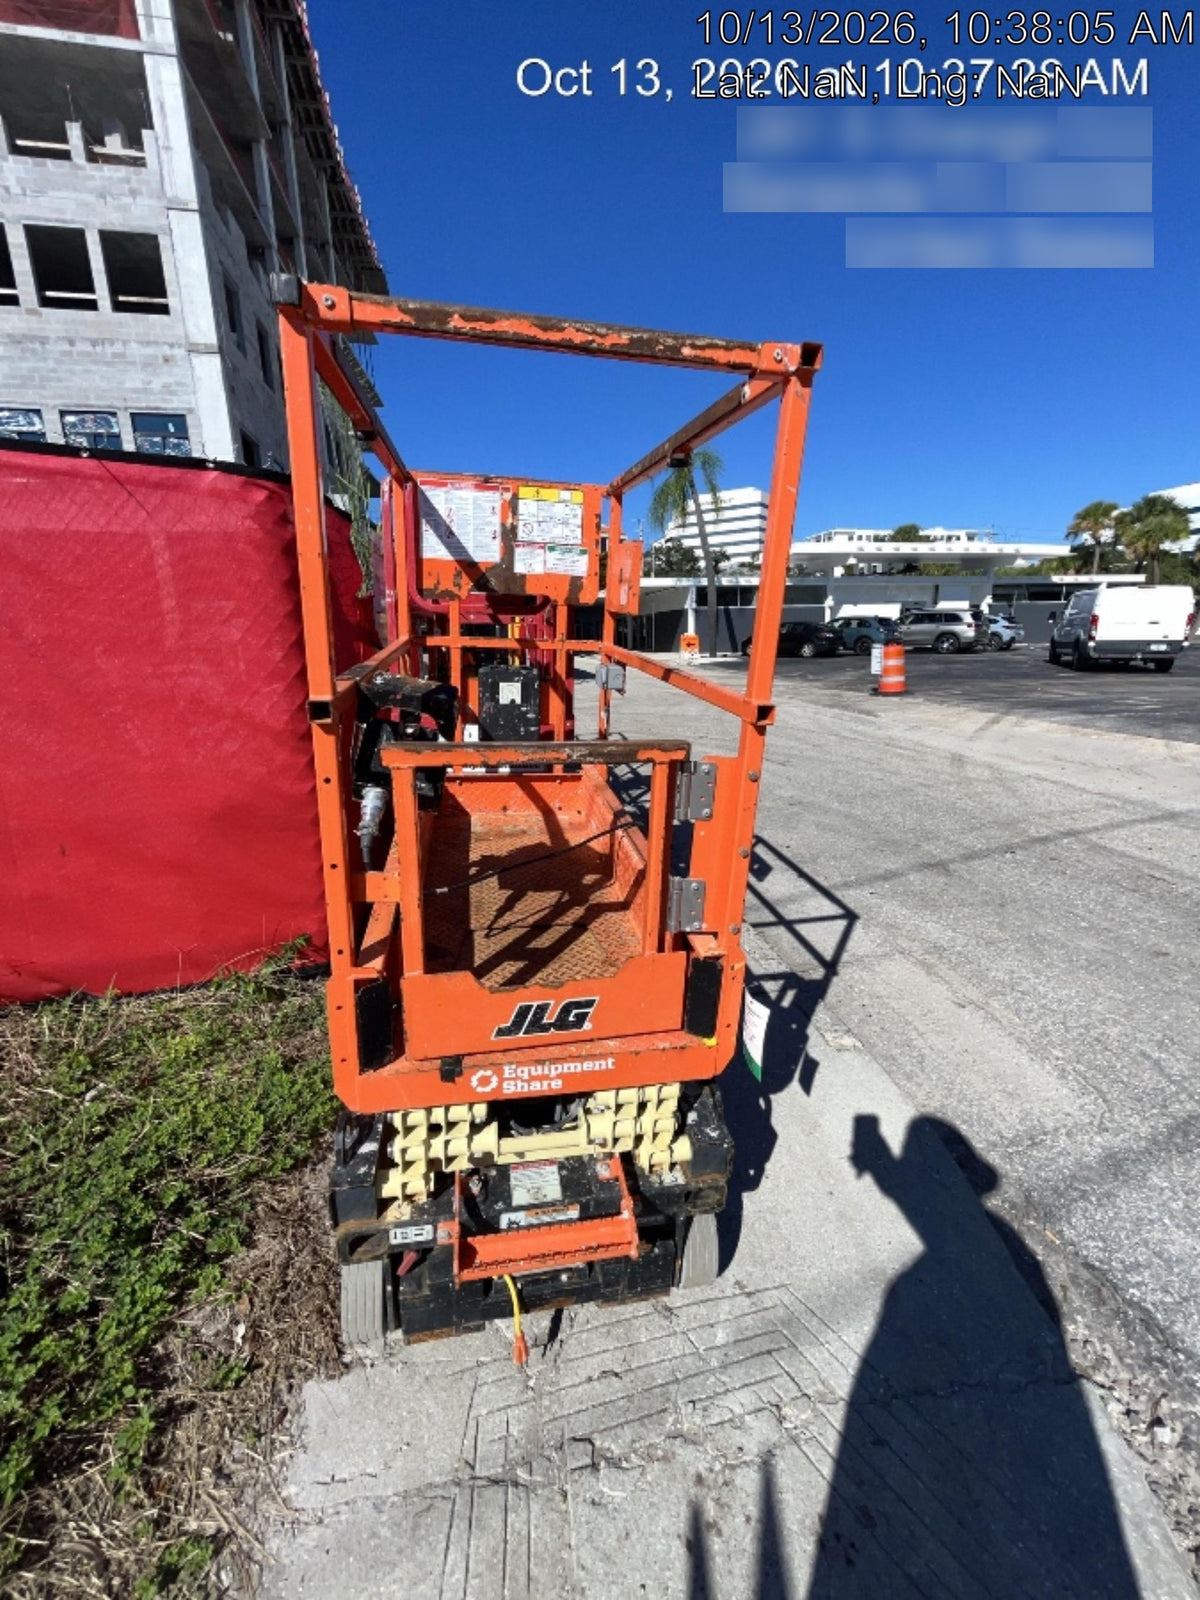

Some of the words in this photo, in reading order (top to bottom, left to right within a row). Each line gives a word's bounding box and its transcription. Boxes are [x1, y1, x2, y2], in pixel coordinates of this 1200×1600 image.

[491, 996, 600, 1040] JLG
[502, 1057, 616, 1079] Equipment
[502, 1078, 563, 1094] Share
